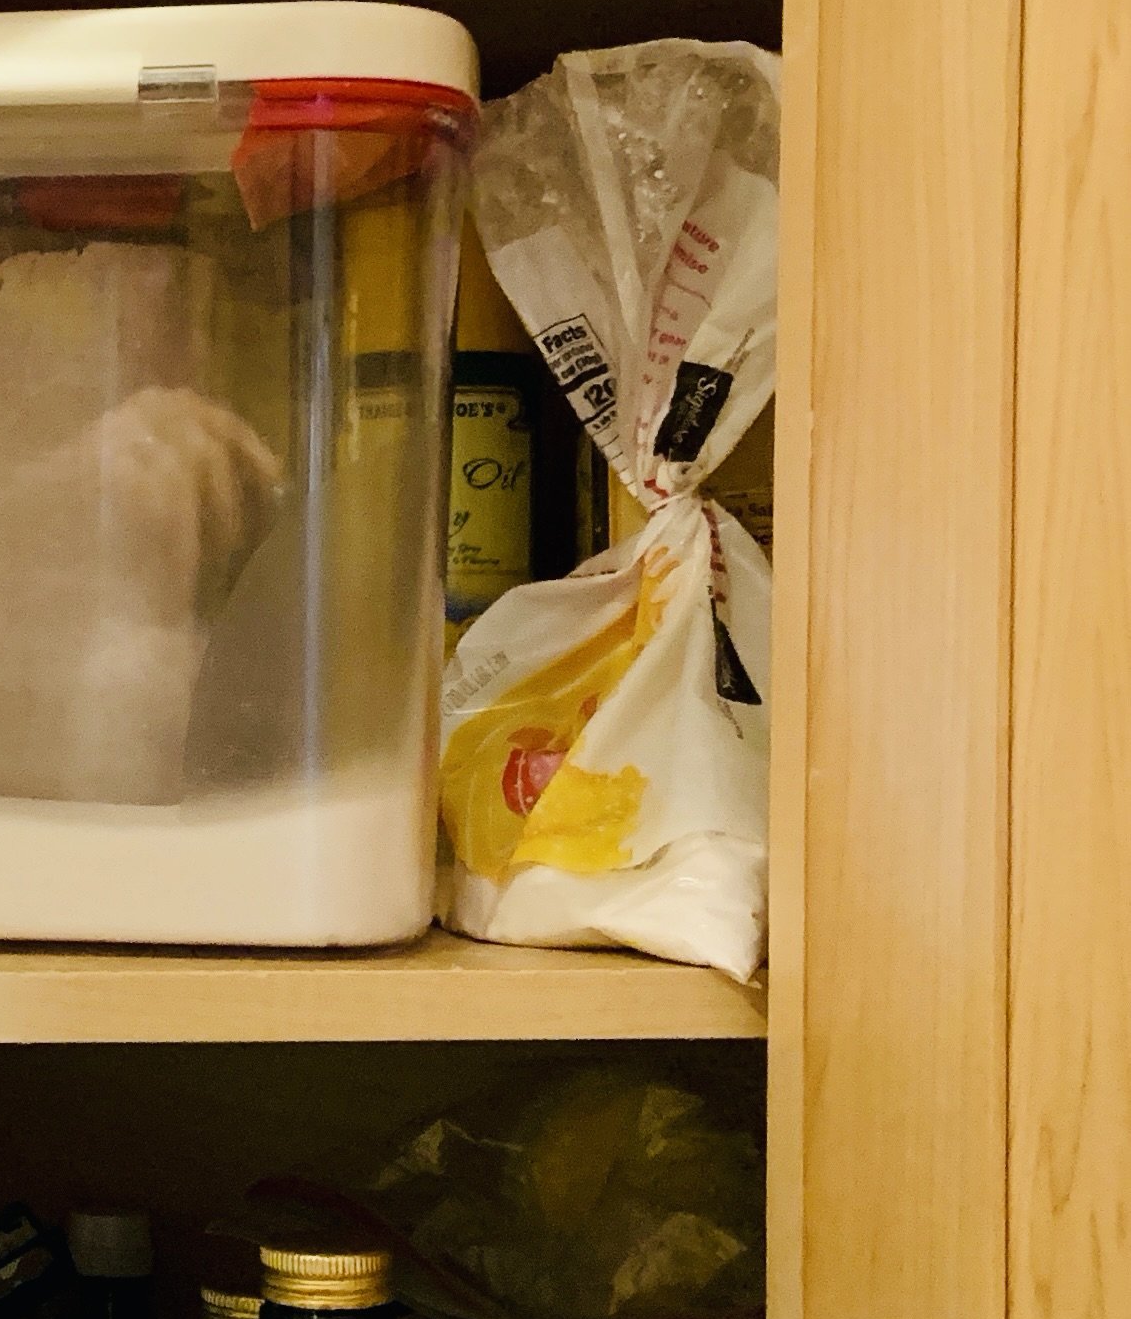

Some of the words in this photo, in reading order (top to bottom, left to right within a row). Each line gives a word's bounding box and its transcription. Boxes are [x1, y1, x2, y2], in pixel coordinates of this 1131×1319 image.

[541, 325, 588, 354] Facts
[455, 401, 495, 419] OE'S
[463, 457, 525, 492] Oil
